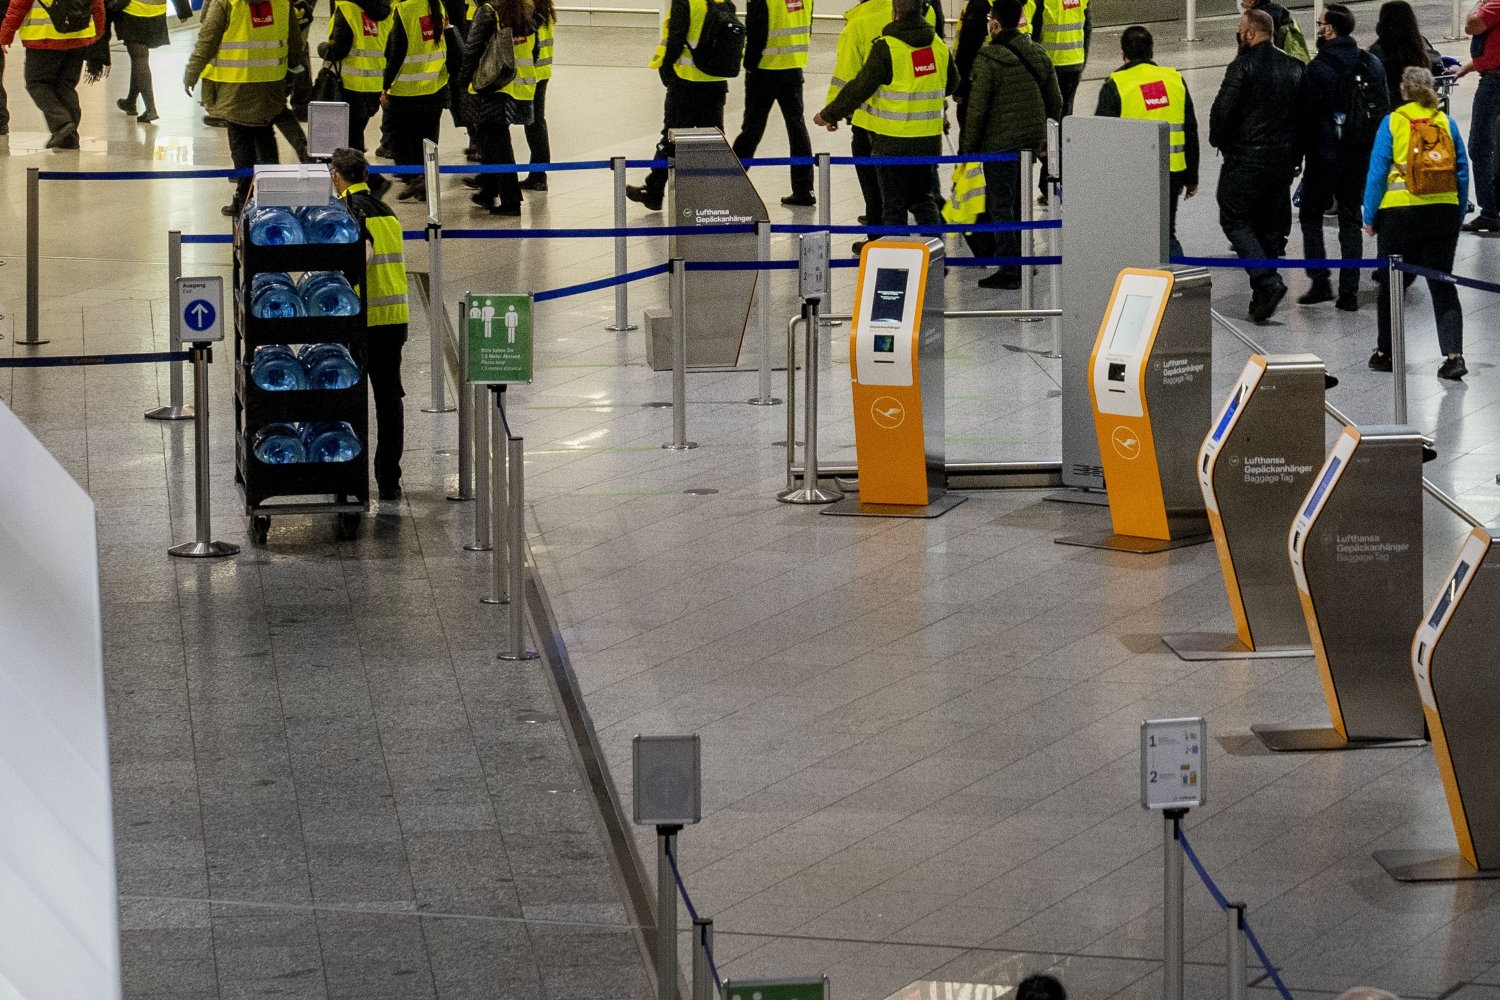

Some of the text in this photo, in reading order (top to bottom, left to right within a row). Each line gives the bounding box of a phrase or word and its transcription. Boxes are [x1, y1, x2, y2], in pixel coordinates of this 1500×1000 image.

[914, 63, 935, 72] ver.di
[1146, 96, 1168, 105] ver.di
[696, 215, 752, 223] Gepäckanhänger
[1244, 457, 1285, 465] Lufthansa
[1244, 465, 1313, 474] Gepäckanhänger
[1244, 474, 1293, 484] Baggage Tag
[1337, 535, 1380, 543] Lufthansa
[1337, 543, 1409, 553] Gepäckanhänger
[1337, 553, 1389, 563] Baggage Tag
[1149, 735, 1157, 747] 1
[1150, 771, 1158, 783] 2
